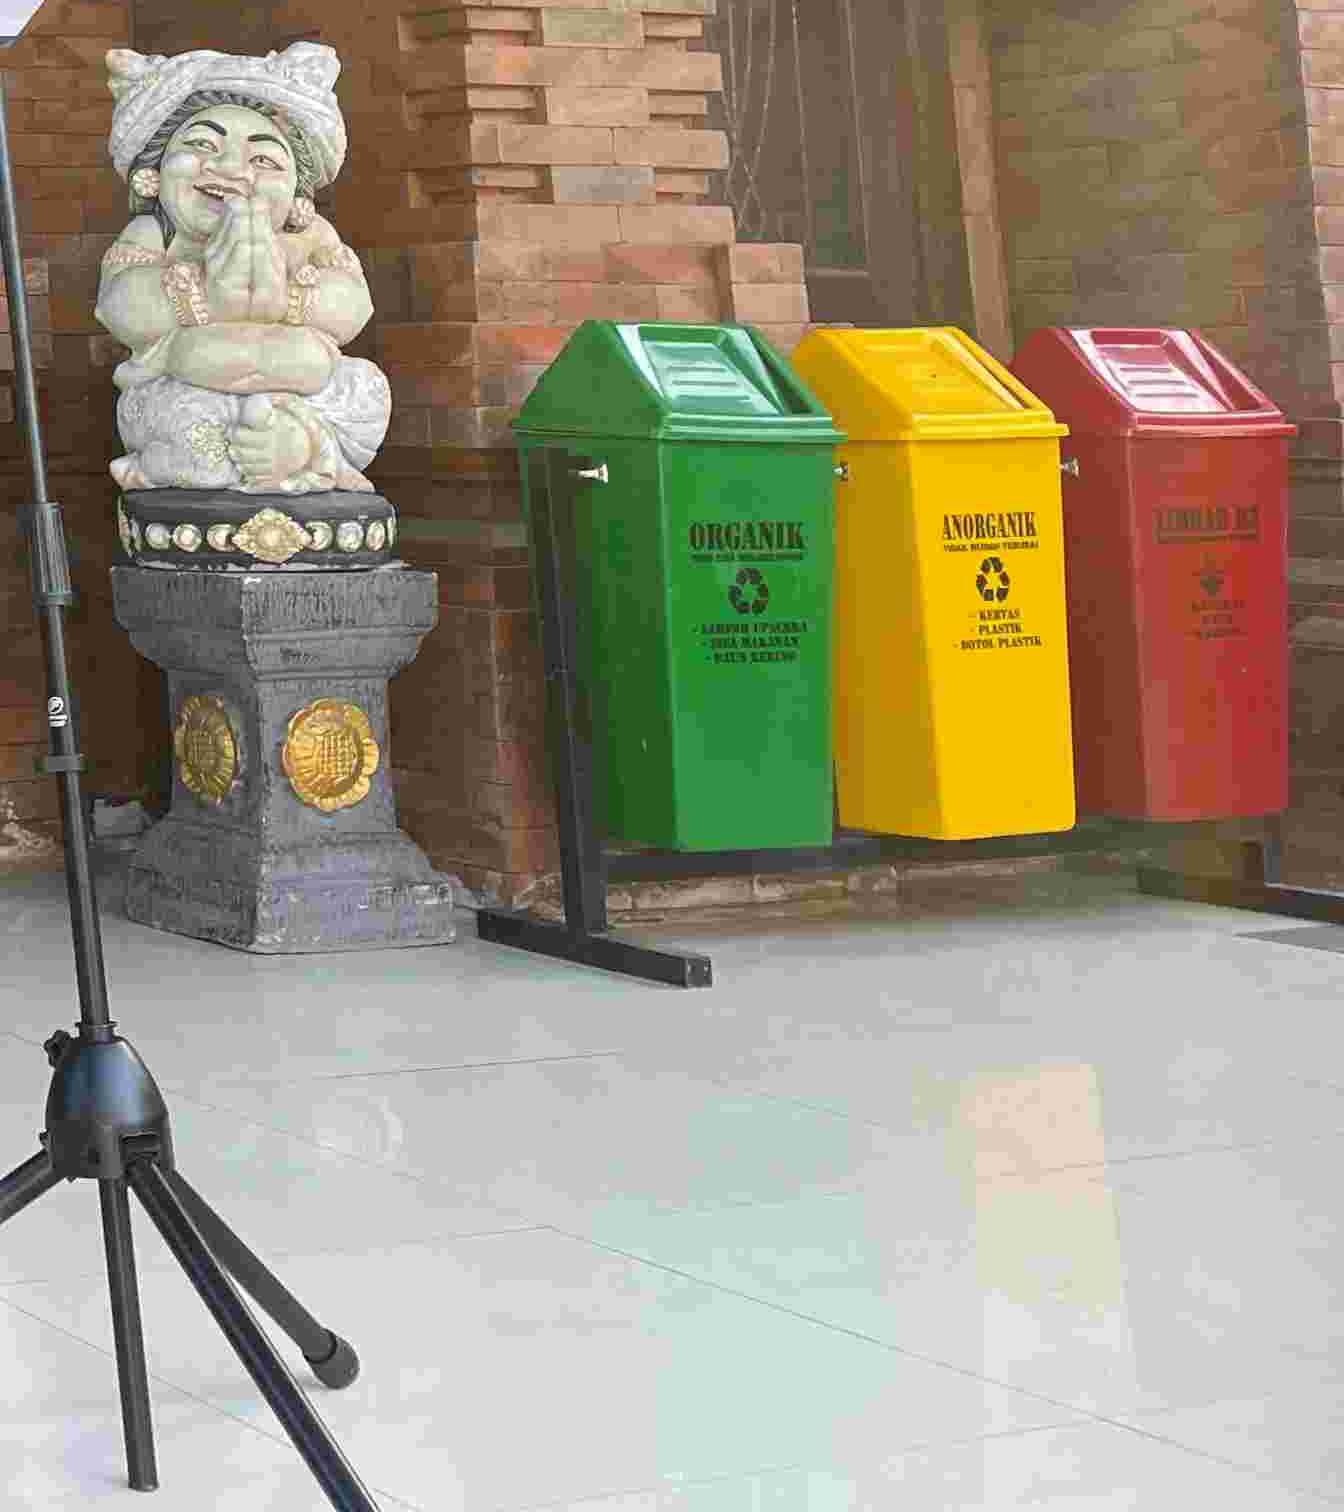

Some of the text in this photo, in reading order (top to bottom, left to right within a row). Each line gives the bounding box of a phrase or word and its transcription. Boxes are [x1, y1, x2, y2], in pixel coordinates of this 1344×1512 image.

[688, 519, 807, 550] ORGANIK
[943, 512, 1038, 540] ANORGANIK
[978, 623, 1022, 635] PLASTIK
[997, 636, 1042, 649] PLASTIK
